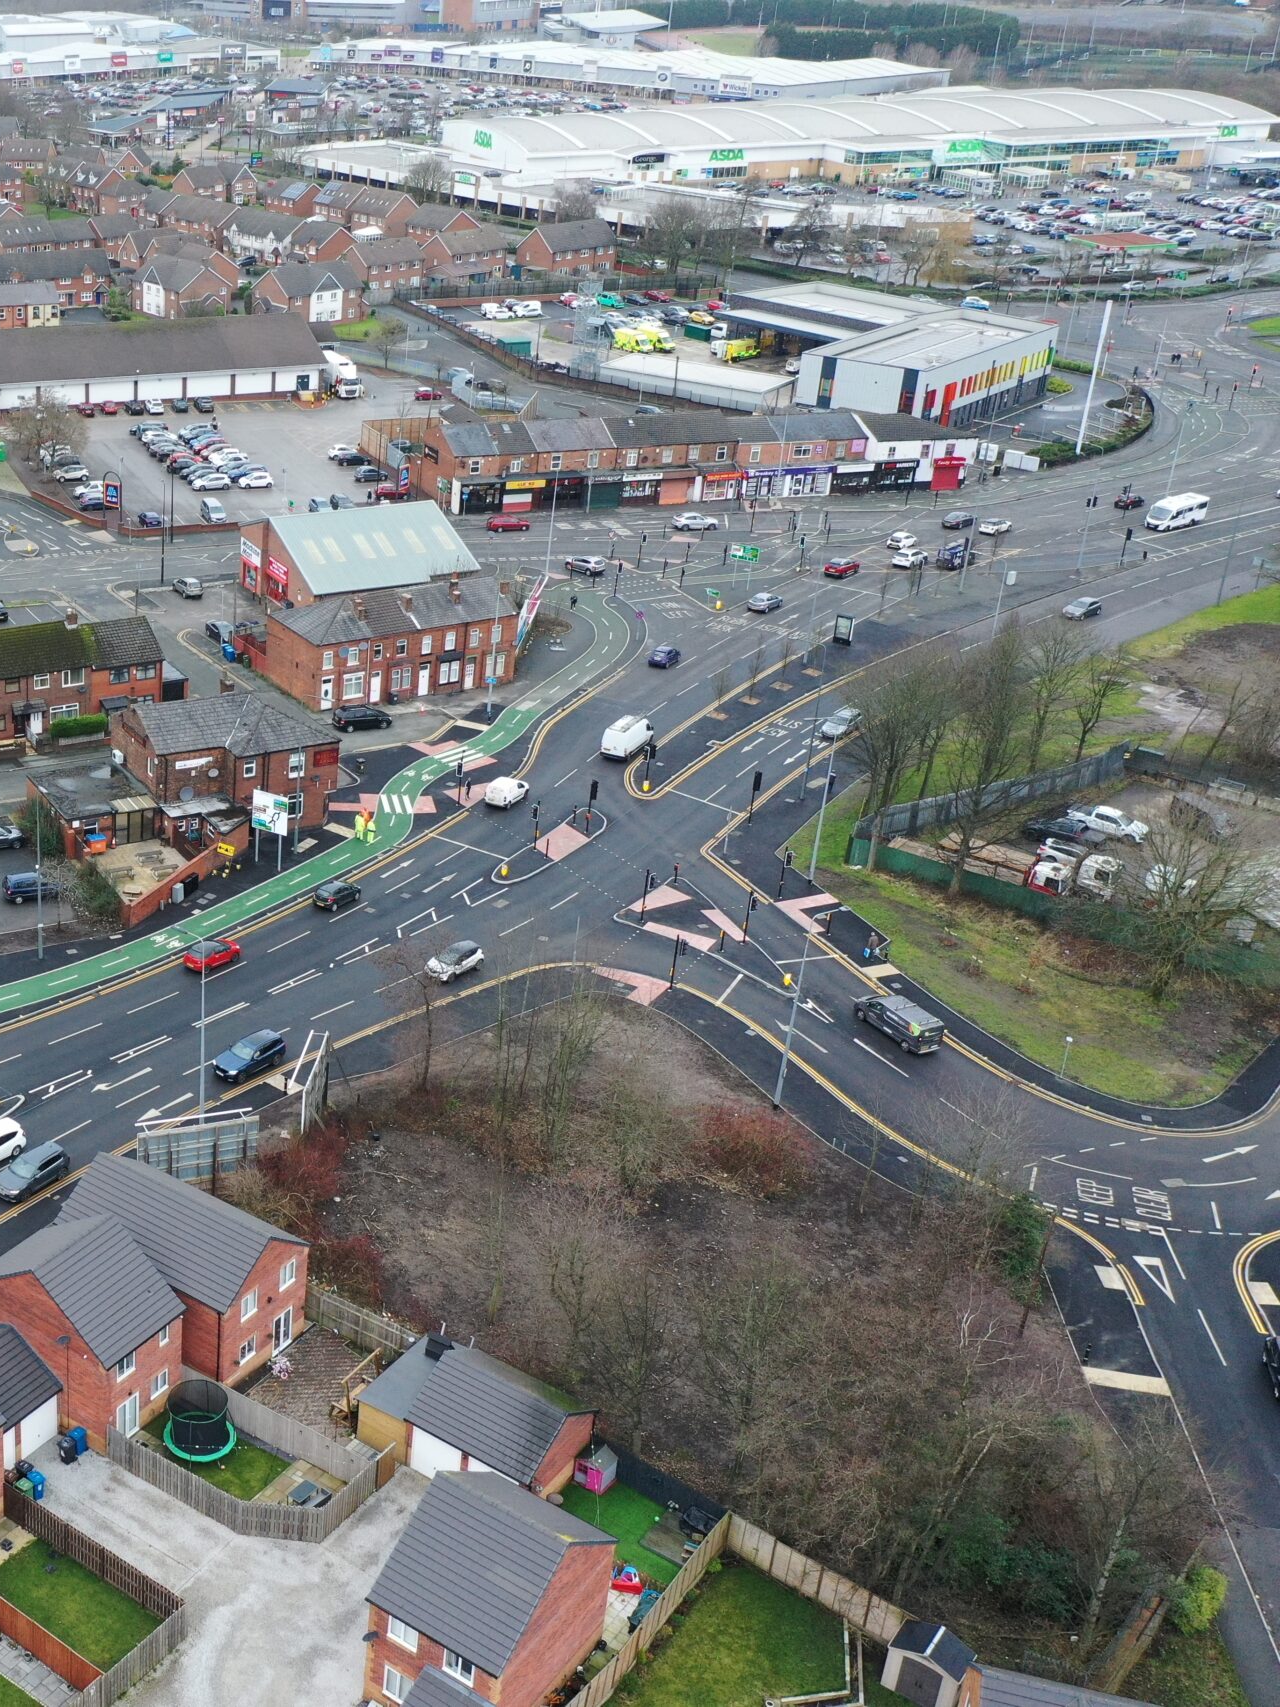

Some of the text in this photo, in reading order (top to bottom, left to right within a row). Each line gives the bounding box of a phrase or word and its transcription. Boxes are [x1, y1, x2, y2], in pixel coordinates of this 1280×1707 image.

[473, 129, 492, 150] ASDA
[709, 149, 744, 161] ASDA
[662, 610, 693, 619] LEFT
[1076, 1178, 1114, 1207] KEEP
[1131, 1187, 1173, 1221] CLEAR
